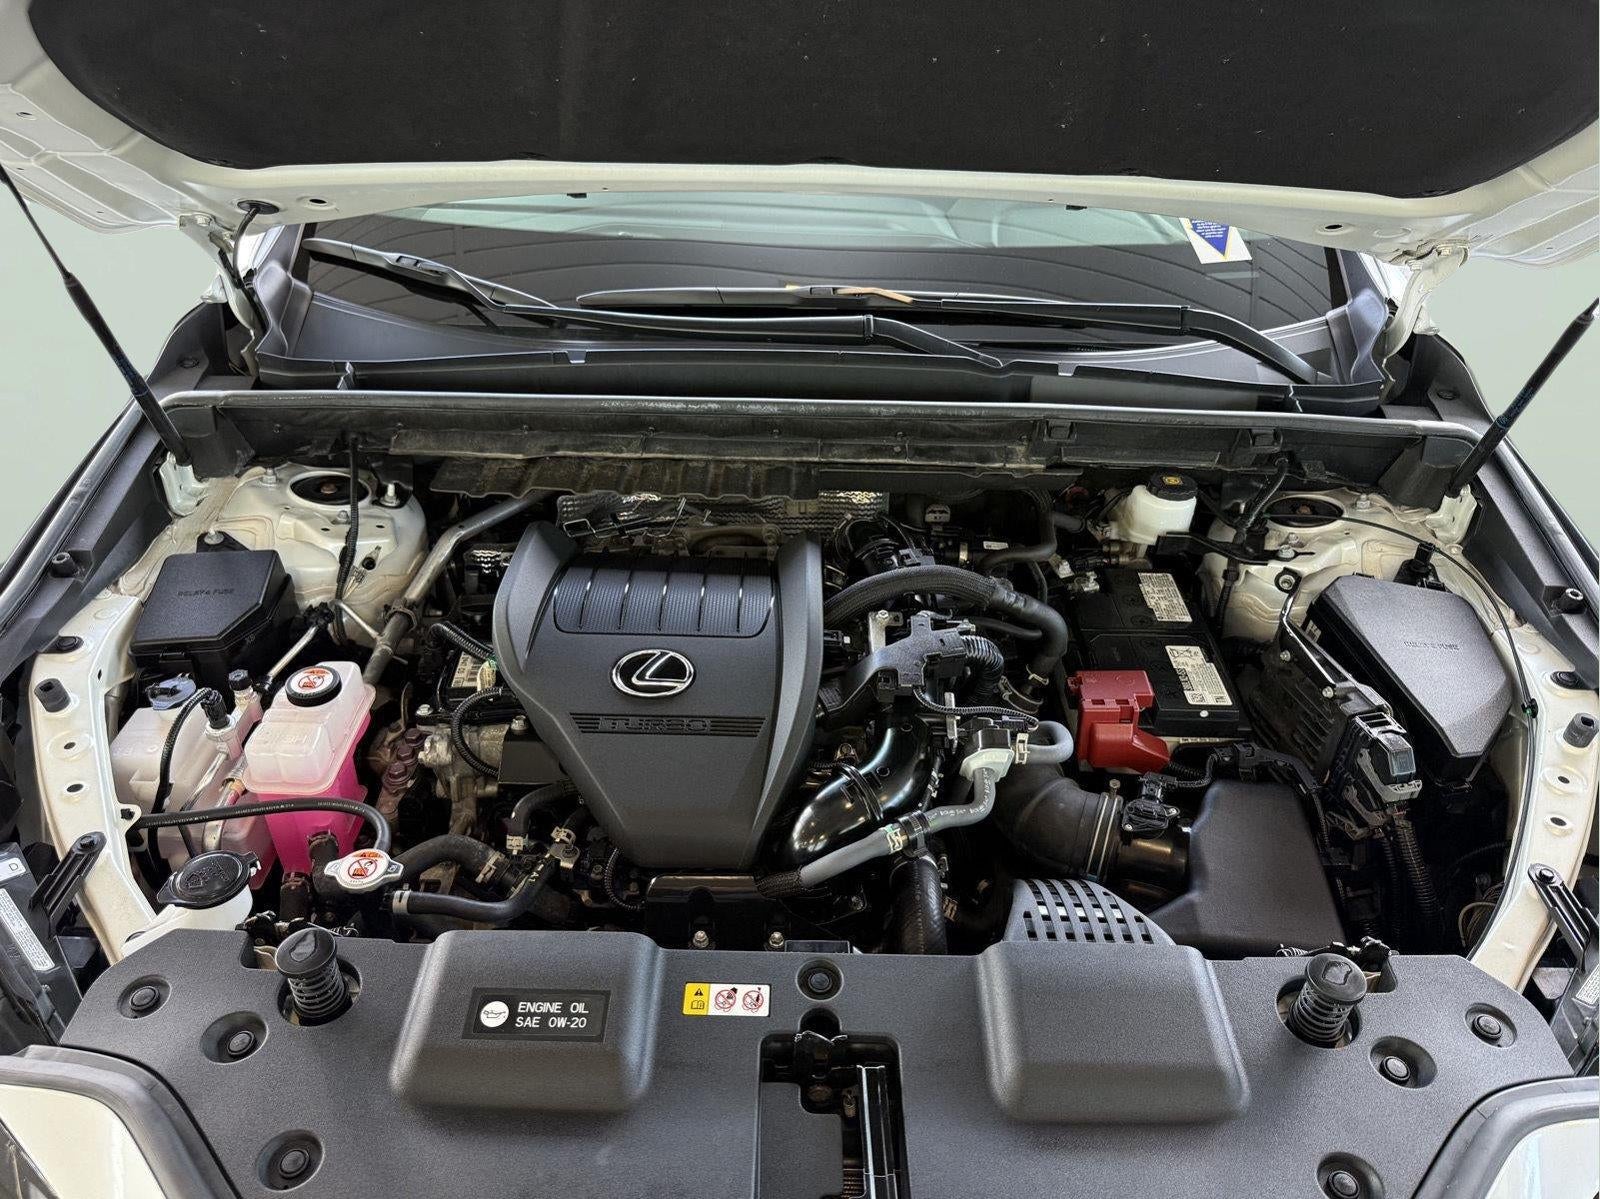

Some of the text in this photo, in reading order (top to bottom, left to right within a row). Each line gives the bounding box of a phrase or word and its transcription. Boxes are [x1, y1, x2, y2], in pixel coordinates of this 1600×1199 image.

[604, 717, 710, 734] TURBO
[517, 1001, 589, 1014] ENGINE OIL
[514, 1016, 588, 1029] SAE 0W-20
